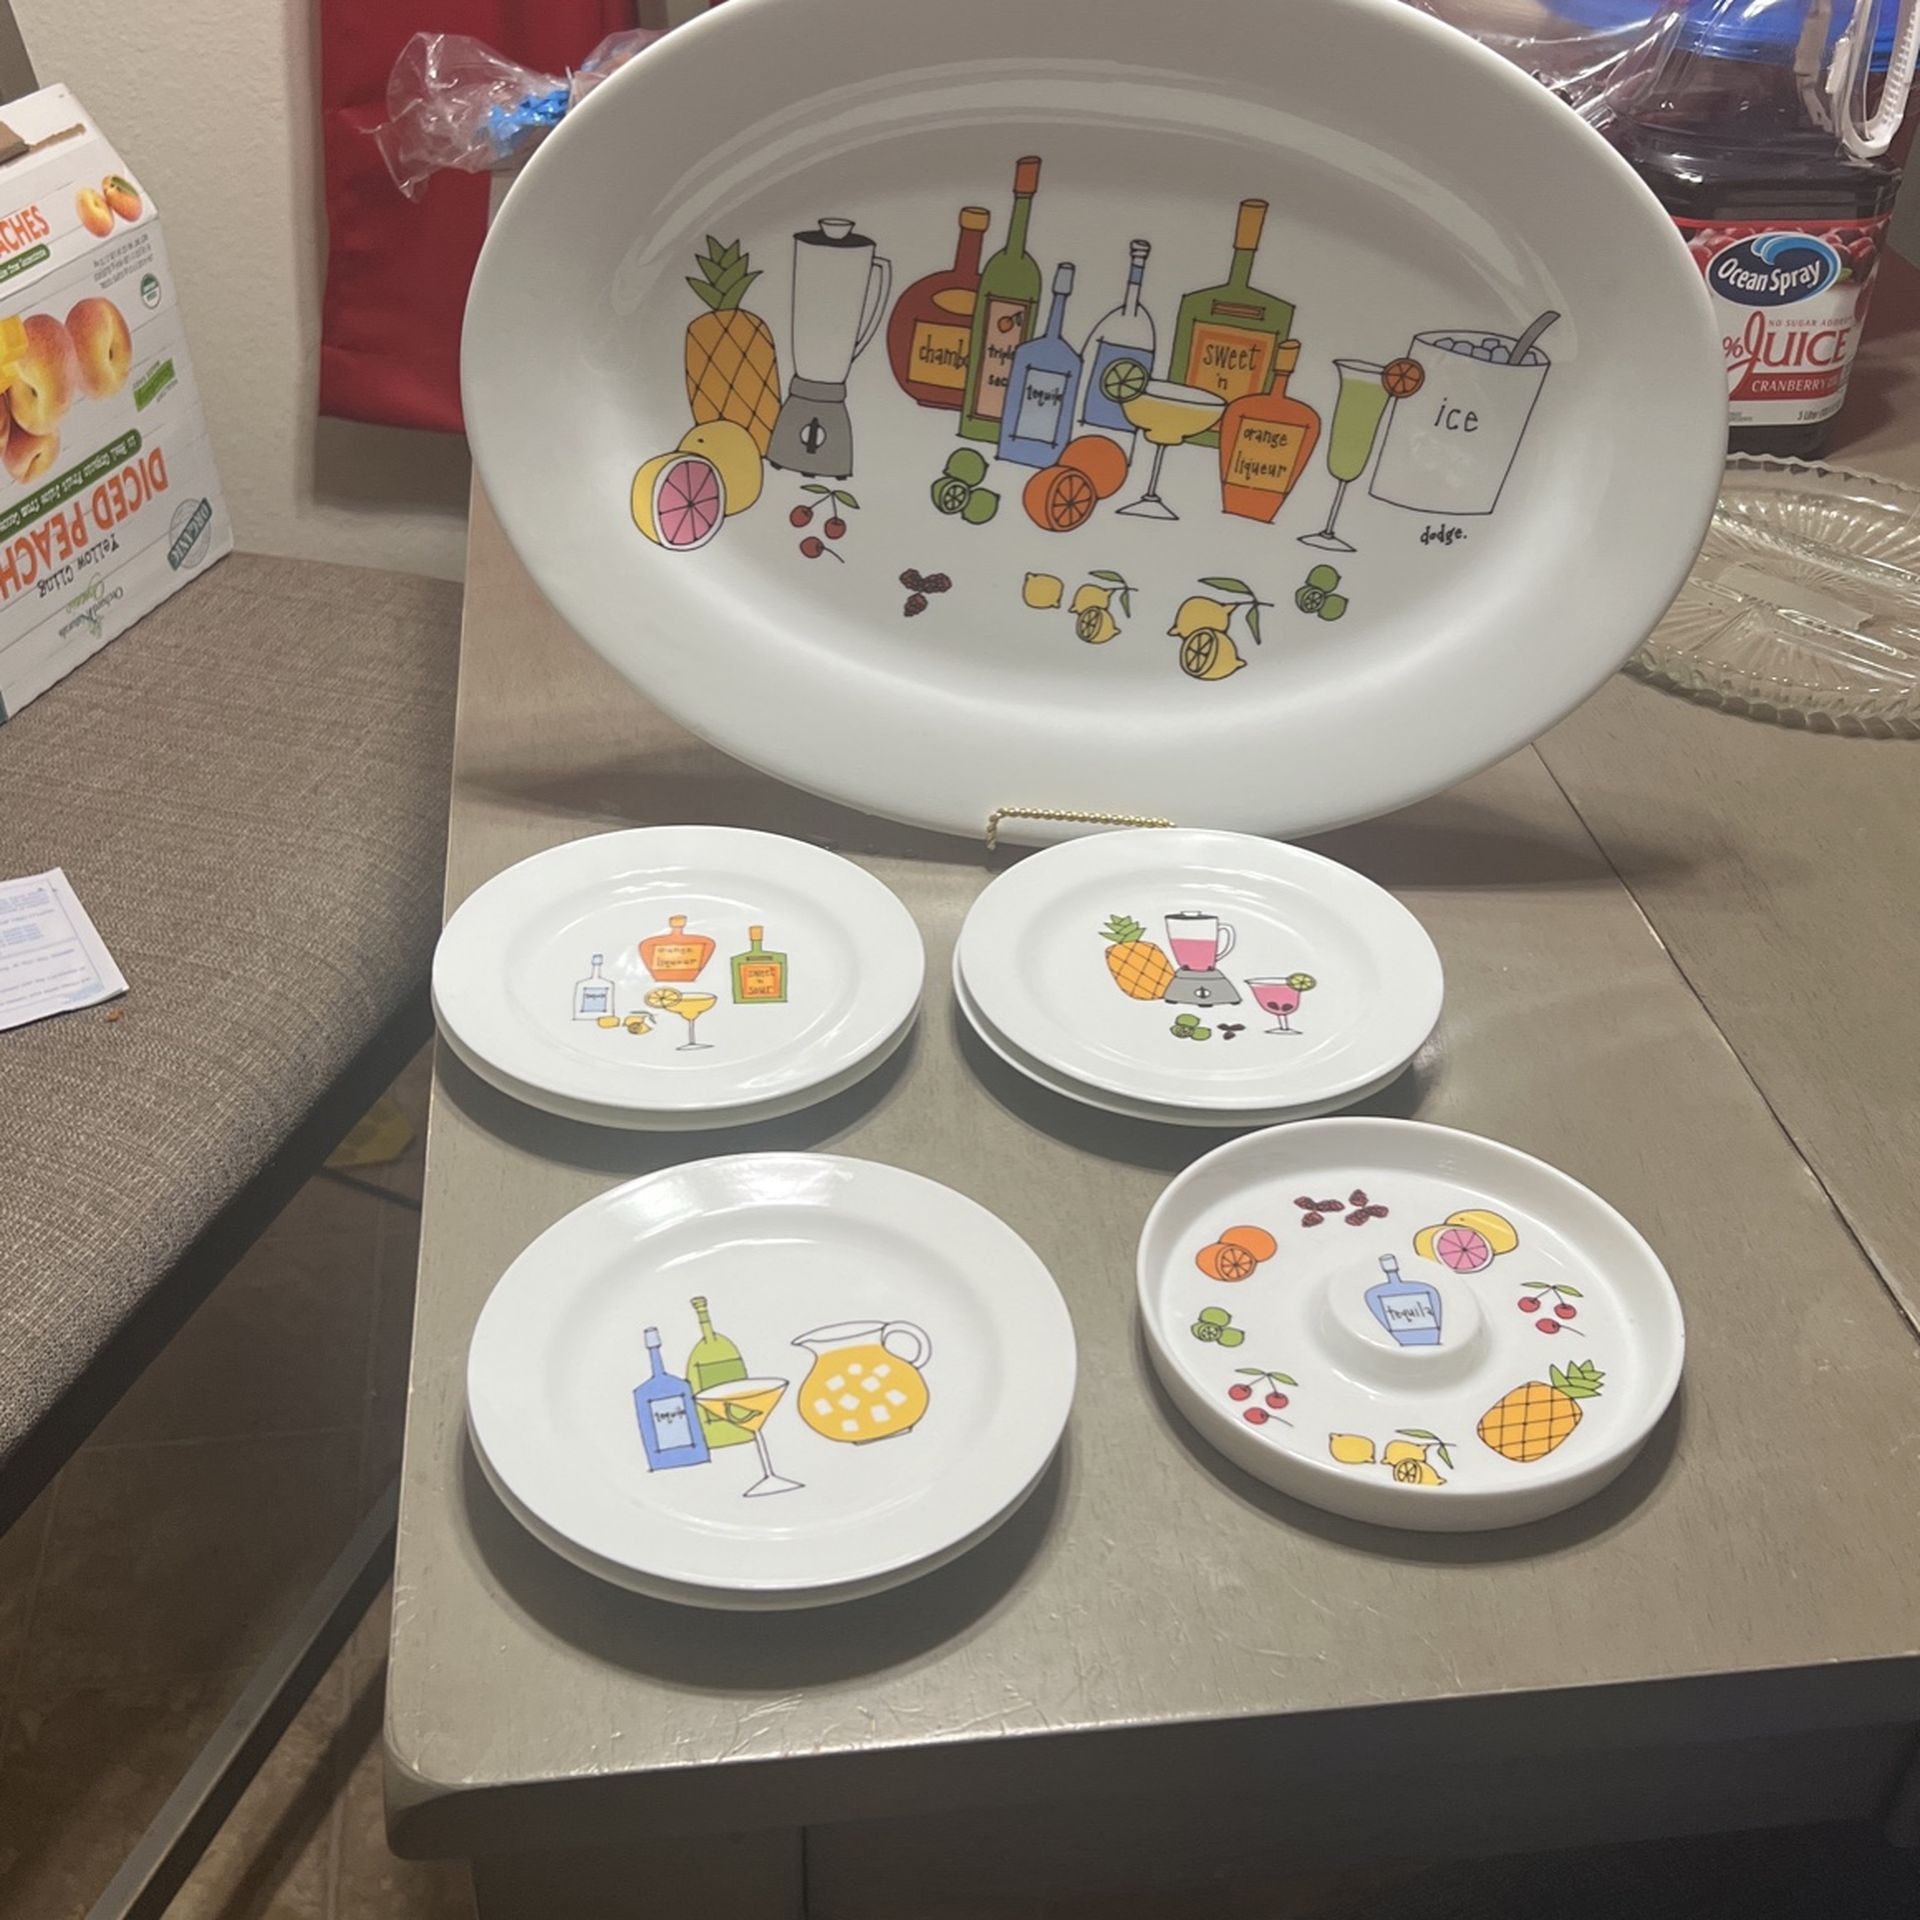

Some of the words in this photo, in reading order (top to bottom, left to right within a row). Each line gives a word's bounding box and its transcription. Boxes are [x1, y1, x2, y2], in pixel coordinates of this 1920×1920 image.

[1718, 258, 1769, 291] Ocean
[1769, 260, 1820, 296] Spray
[1743, 310, 1852, 370] JUICE
[1203, 343, 1261, 370] sweet
[1752, 379, 1826, 393] CRANBERRY
[1434, 397, 1479, 432] ice
[1243, 426, 1288, 448] orange
[1234, 451, 1287, 480] liqueur
[91, 446, 169, 531] DICED
[1420, 523, 1468, 546] dodge.
[77, 533, 120, 571] Yellow
[36, 565, 75, 599] Cling
[1386, 1300, 1435, 1323] tequila
